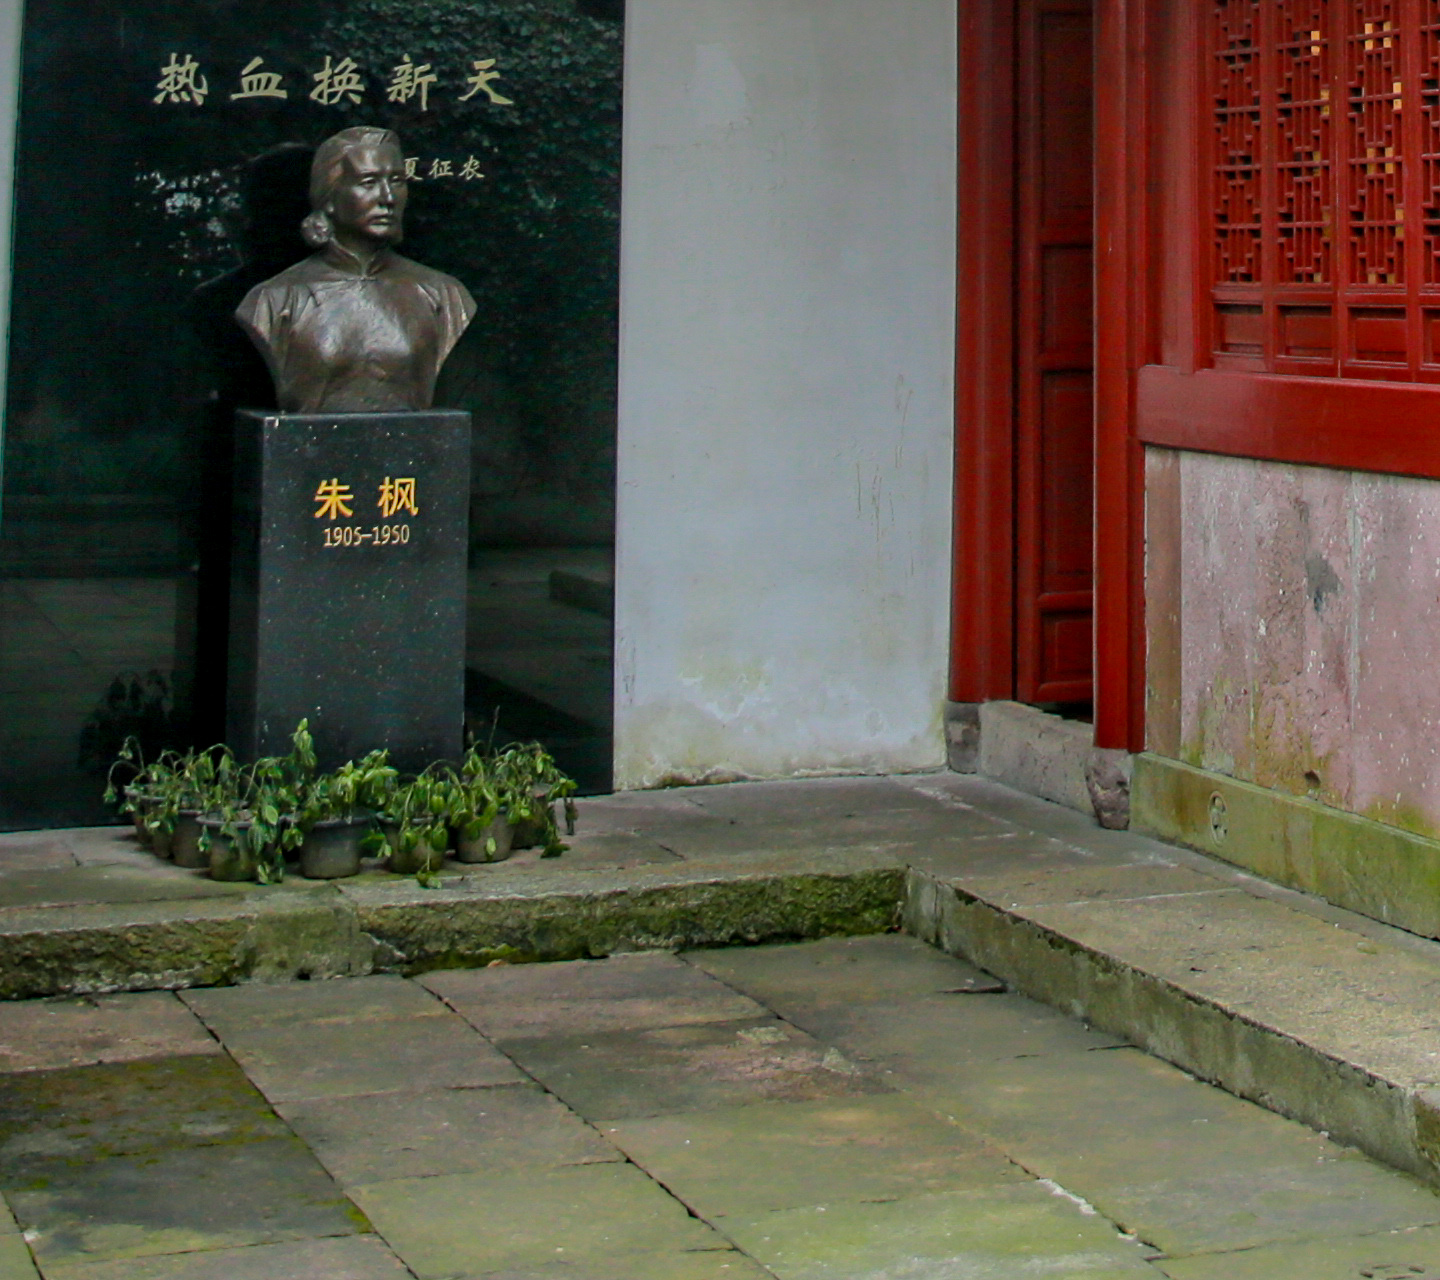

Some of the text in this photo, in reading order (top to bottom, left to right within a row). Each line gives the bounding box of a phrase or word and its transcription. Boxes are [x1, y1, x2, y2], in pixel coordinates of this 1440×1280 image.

[152, 52, 514, 112] 热血换新天
[404, 154, 485, 180] 夏征农
[314, 476, 419, 520] 朱枫
